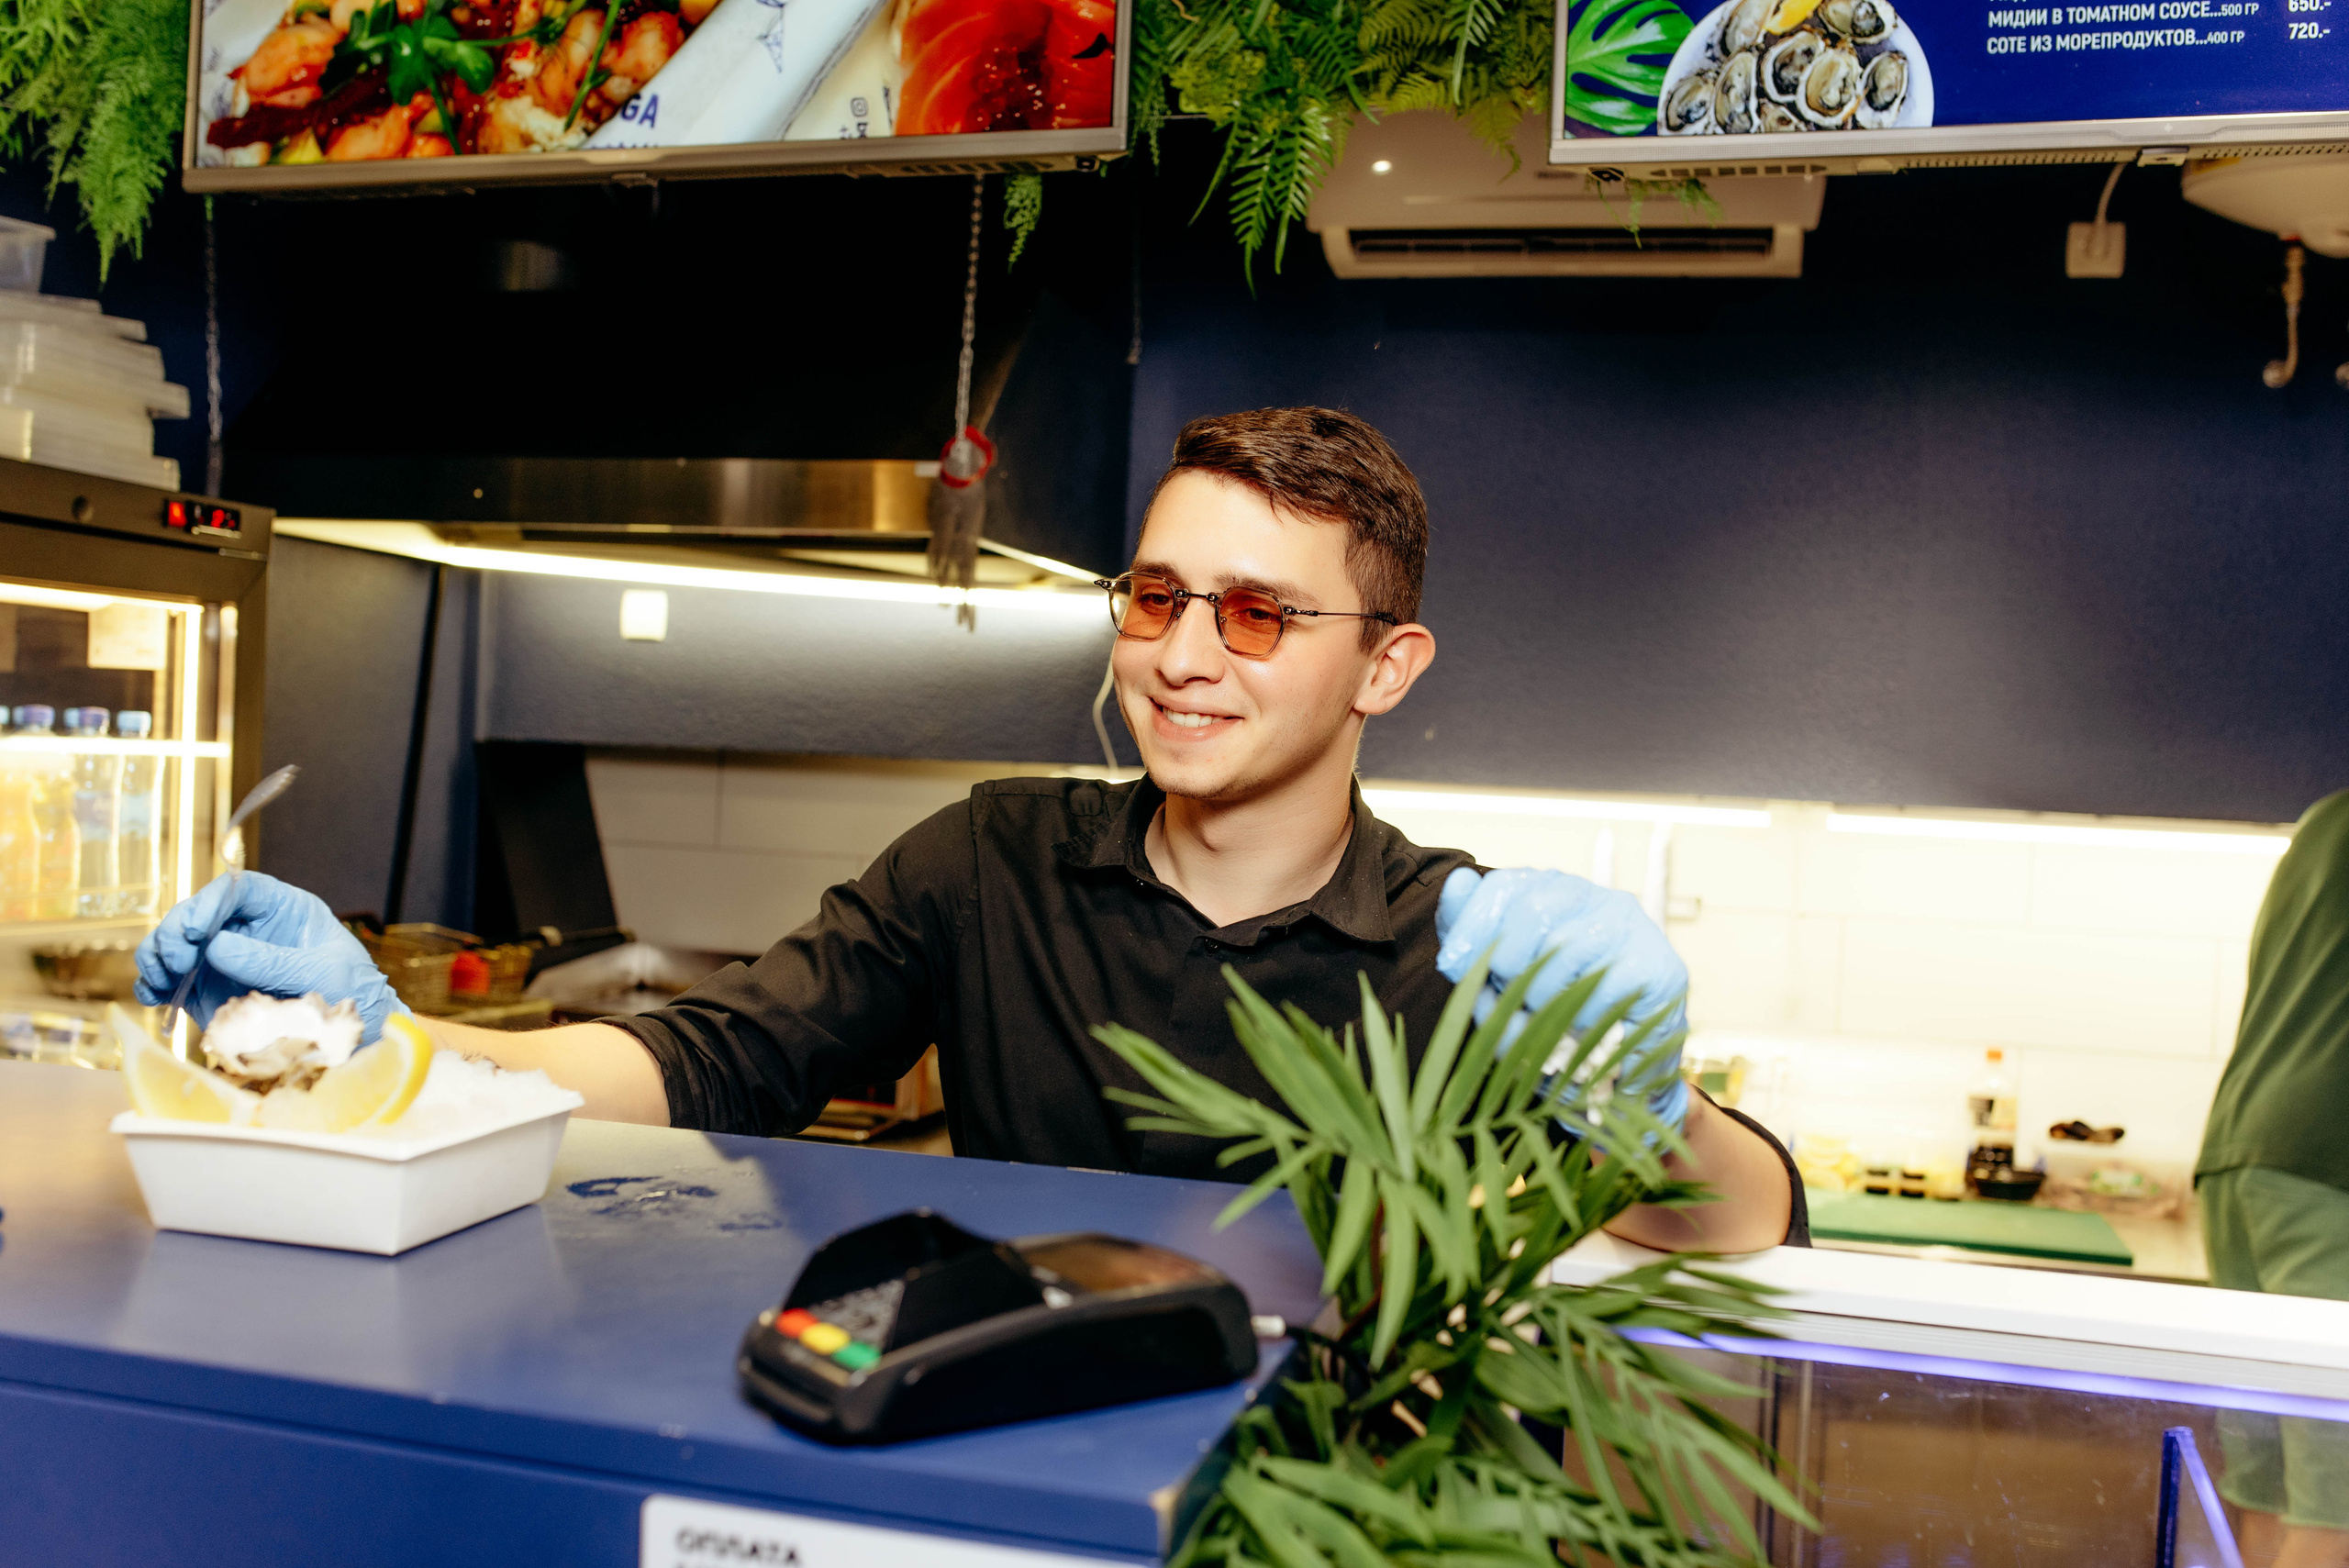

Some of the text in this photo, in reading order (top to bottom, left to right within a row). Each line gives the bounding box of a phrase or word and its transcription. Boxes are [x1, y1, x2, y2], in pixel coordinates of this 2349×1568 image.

[1987, 8, 2048, 29] МИДИИ
[2052, 7, 2063, 25] В
[2066, 3, 2155, 24] ТОМАТНОМ
[2244, 3, 2259, 15] ГР
[1987, 36, 2027, 54] СОТЕ
[2031, 34, 2053, 52] ИЗ
[2230, 30, 2245, 43] ГР
